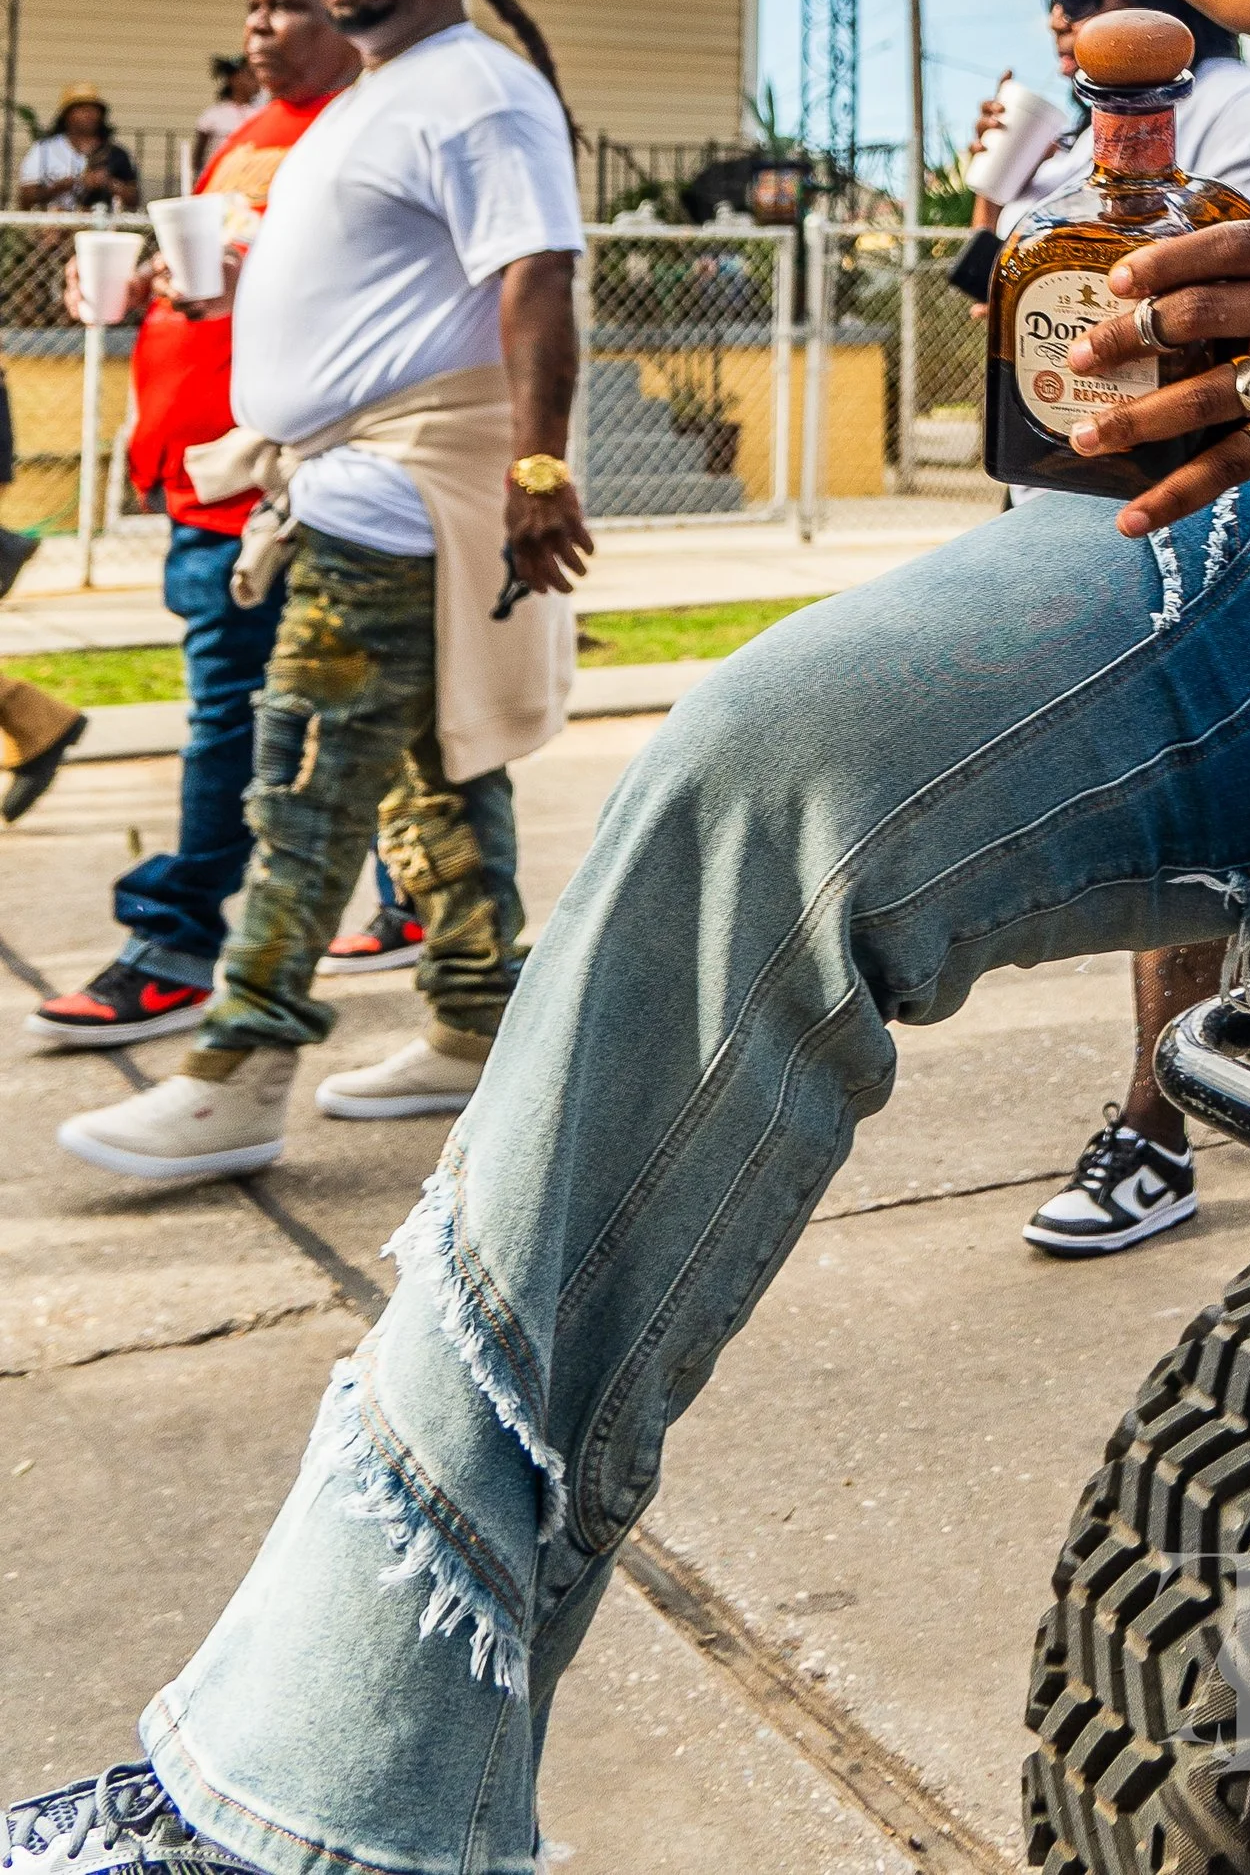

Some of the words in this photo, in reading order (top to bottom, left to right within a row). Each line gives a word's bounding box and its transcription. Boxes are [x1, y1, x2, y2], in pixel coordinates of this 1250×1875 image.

[1025, 311, 1086, 340] Don
[1073, 379, 1119, 391] TEQUILA
[1073, 387, 1136, 404] REPOSAD
